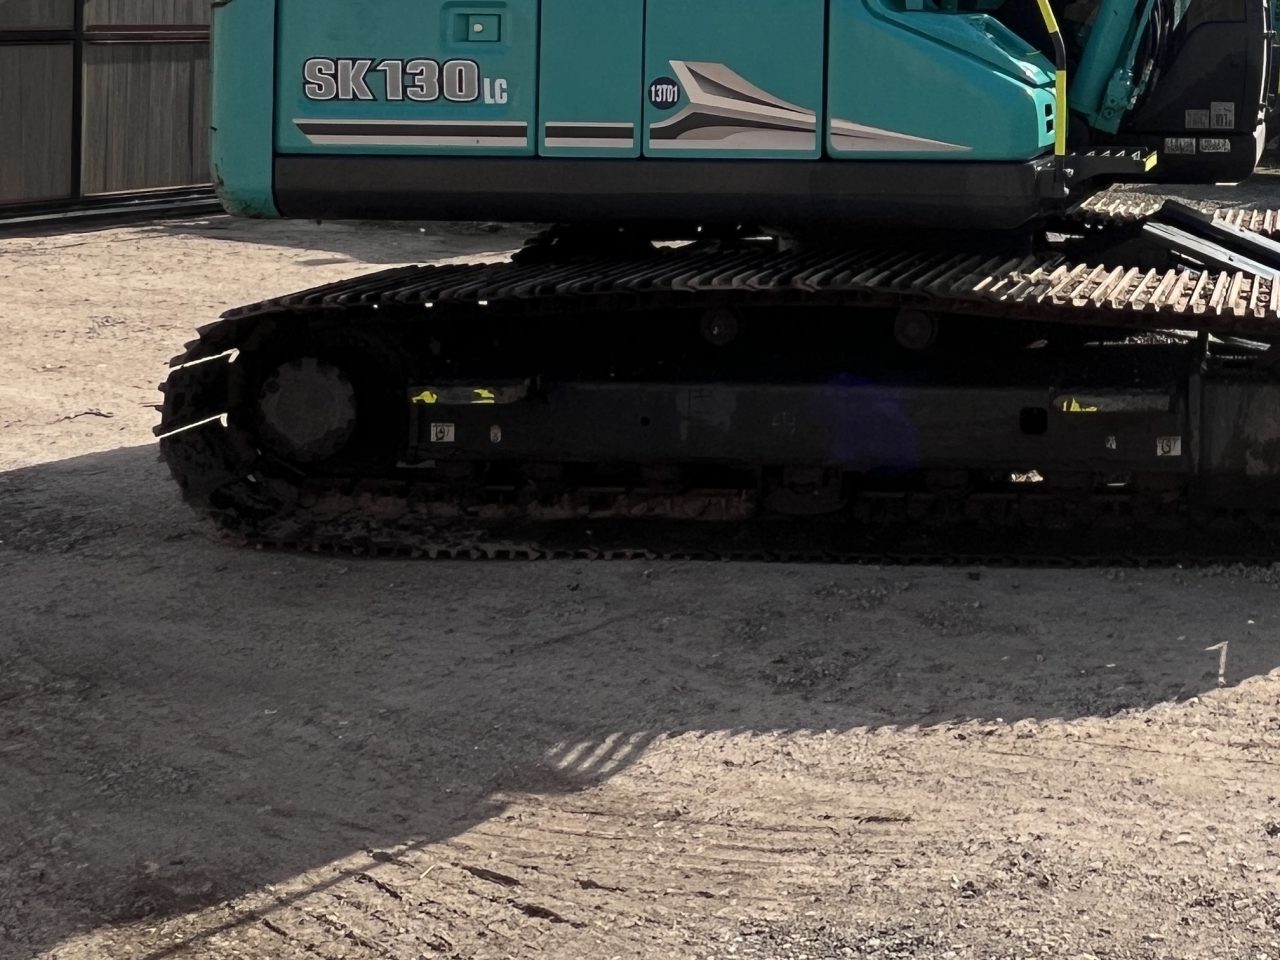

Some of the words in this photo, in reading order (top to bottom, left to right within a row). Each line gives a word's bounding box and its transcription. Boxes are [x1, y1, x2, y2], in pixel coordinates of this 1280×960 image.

[302, 57, 481, 102] SK130
[484, 78, 508, 104] LC
[650, 84, 679, 103] 13T01
